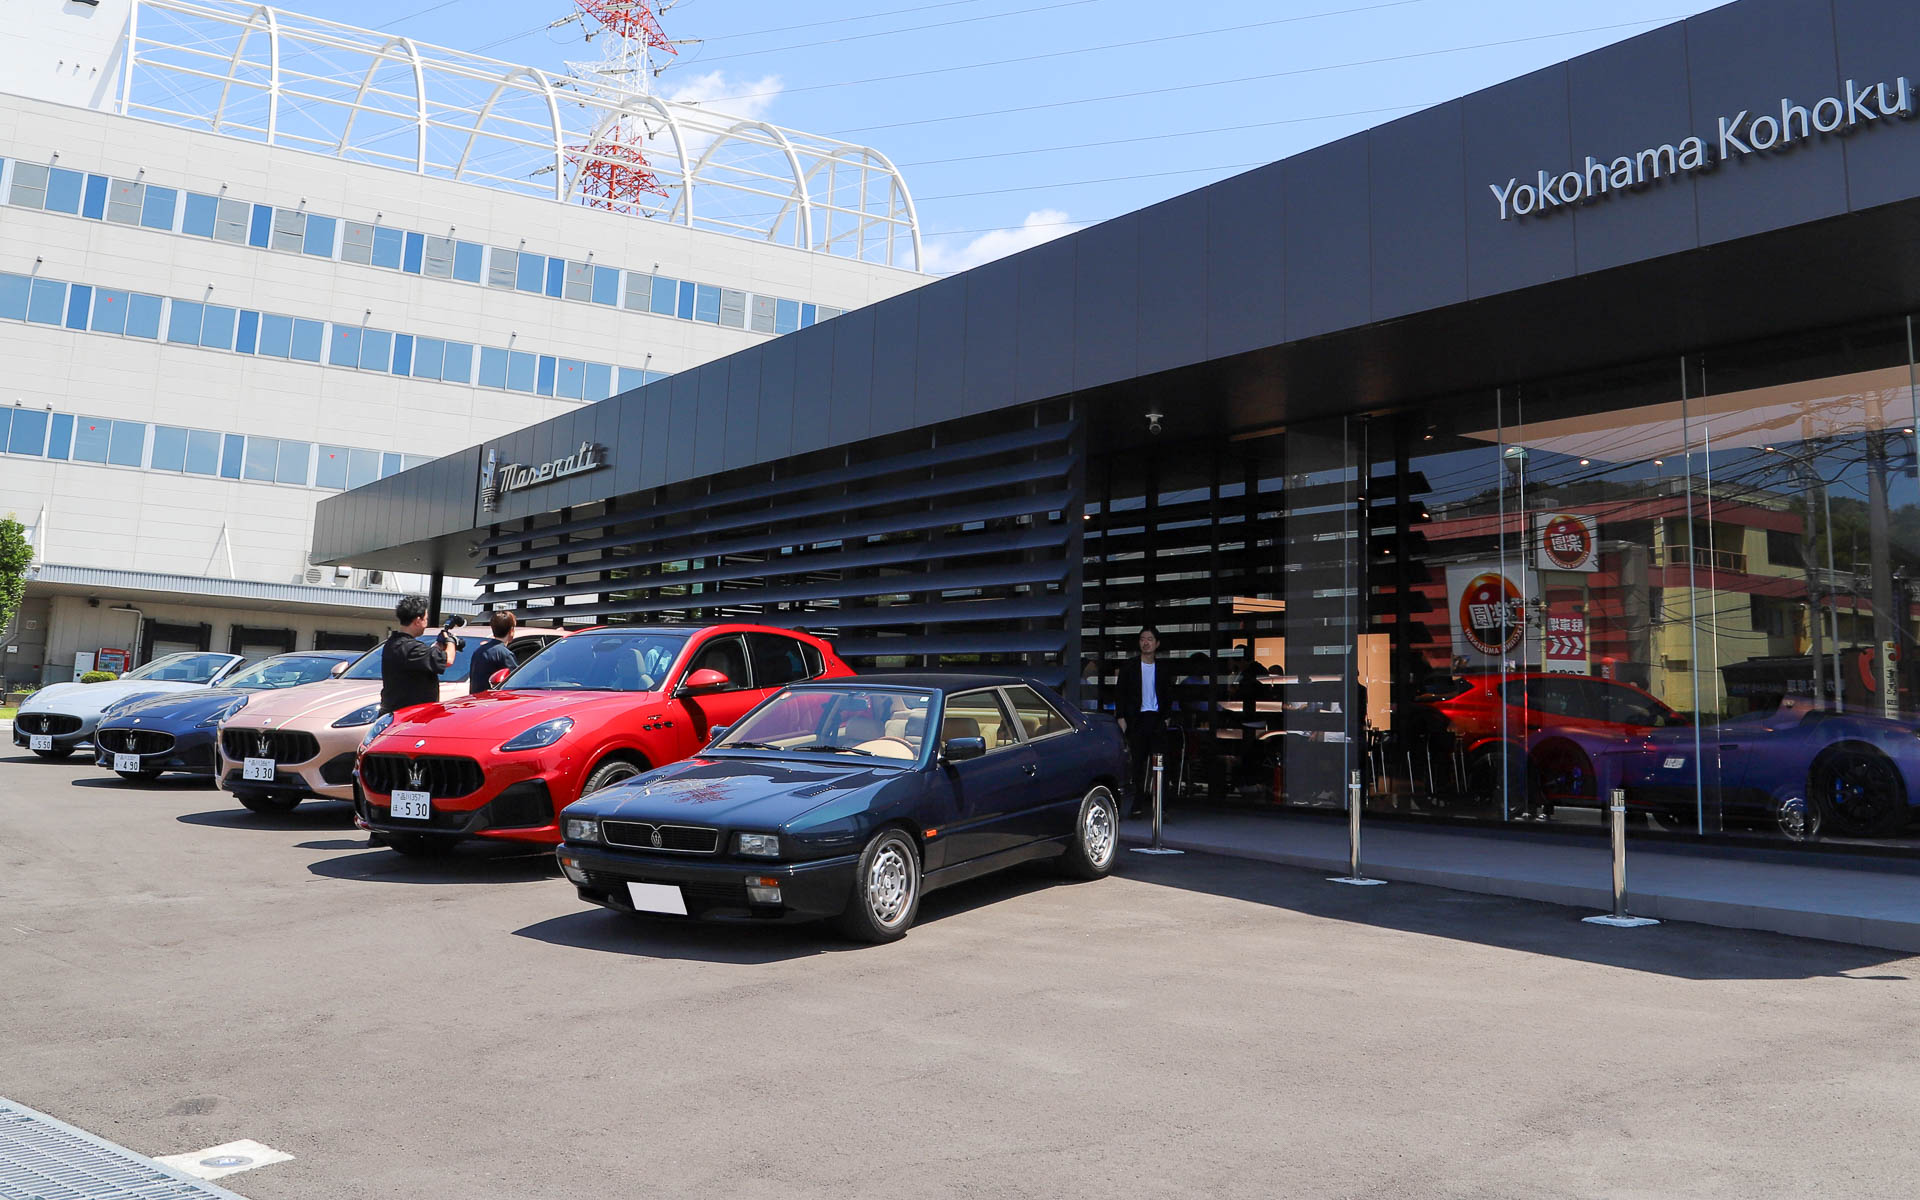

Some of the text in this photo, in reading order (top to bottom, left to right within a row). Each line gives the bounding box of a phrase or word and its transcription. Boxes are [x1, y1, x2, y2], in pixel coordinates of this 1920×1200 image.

[1489, 76, 1911, 220] Yokohama Kohoku
[499, 441, 597, 492] Maserati
